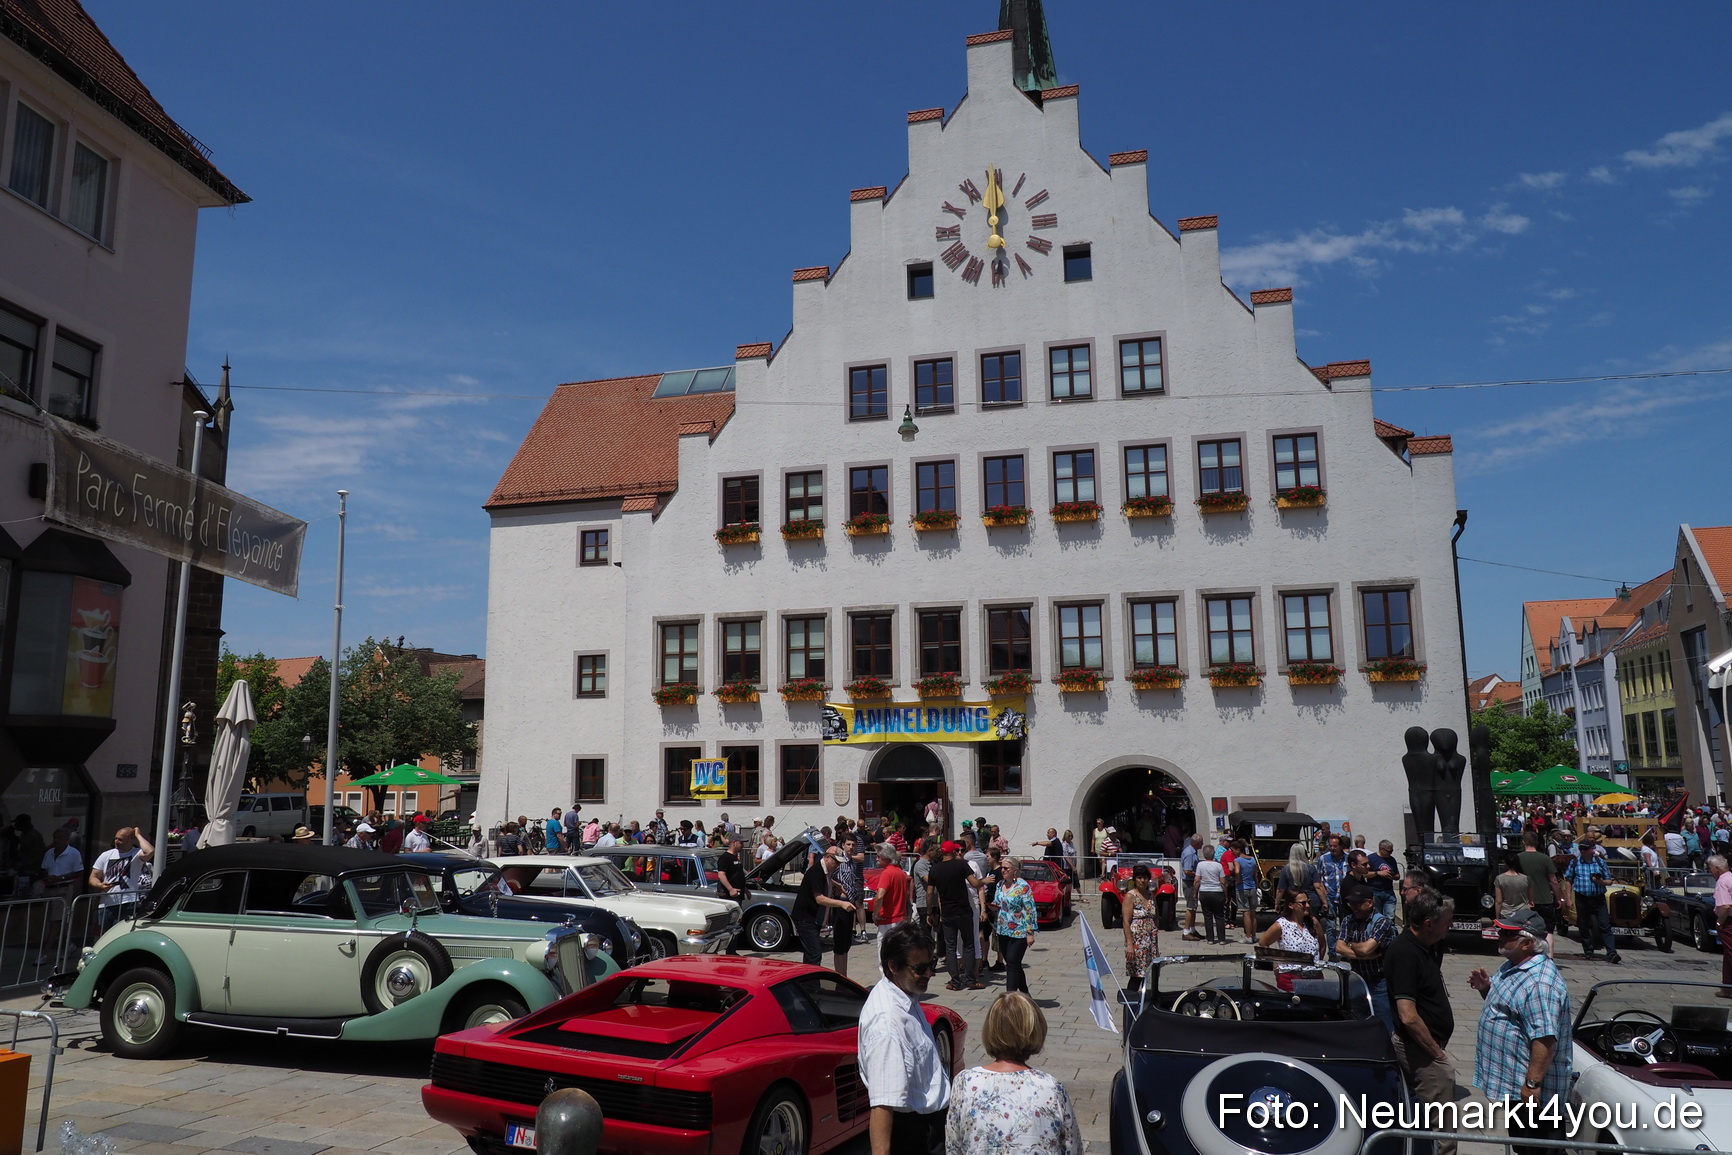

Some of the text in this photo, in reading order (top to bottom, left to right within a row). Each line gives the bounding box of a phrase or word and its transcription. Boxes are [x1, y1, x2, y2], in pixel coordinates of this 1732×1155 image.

[76, 450, 284, 575] Parc Fermé d'Elégance
[852, 706, 990, 735] ANMELDUNG
[693, 760, 726, 786] WC
[38, 788, 61, 802] RACKL
